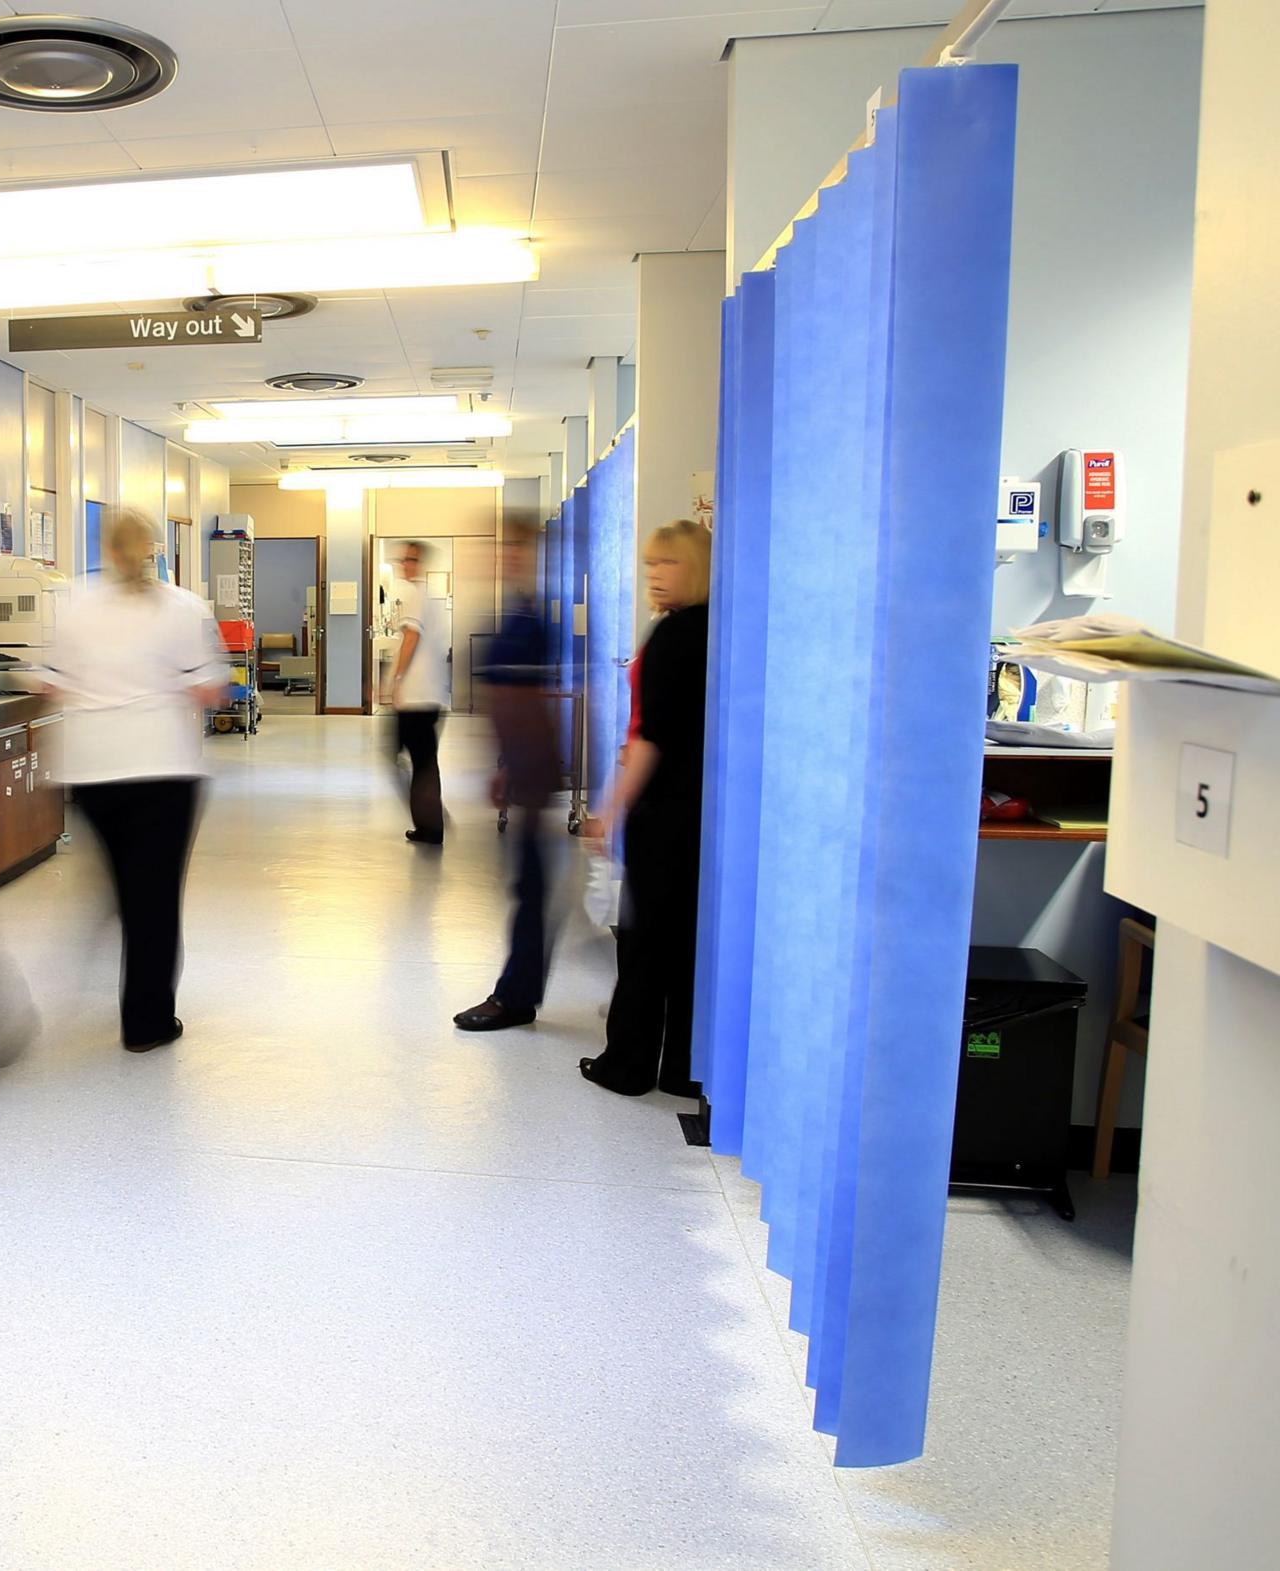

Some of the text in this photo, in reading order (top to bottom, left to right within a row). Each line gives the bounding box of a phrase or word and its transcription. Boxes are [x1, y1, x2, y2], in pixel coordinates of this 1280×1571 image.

[130, 315, 223, 341] Way out
[1196, 782, 1210, 818] 5
